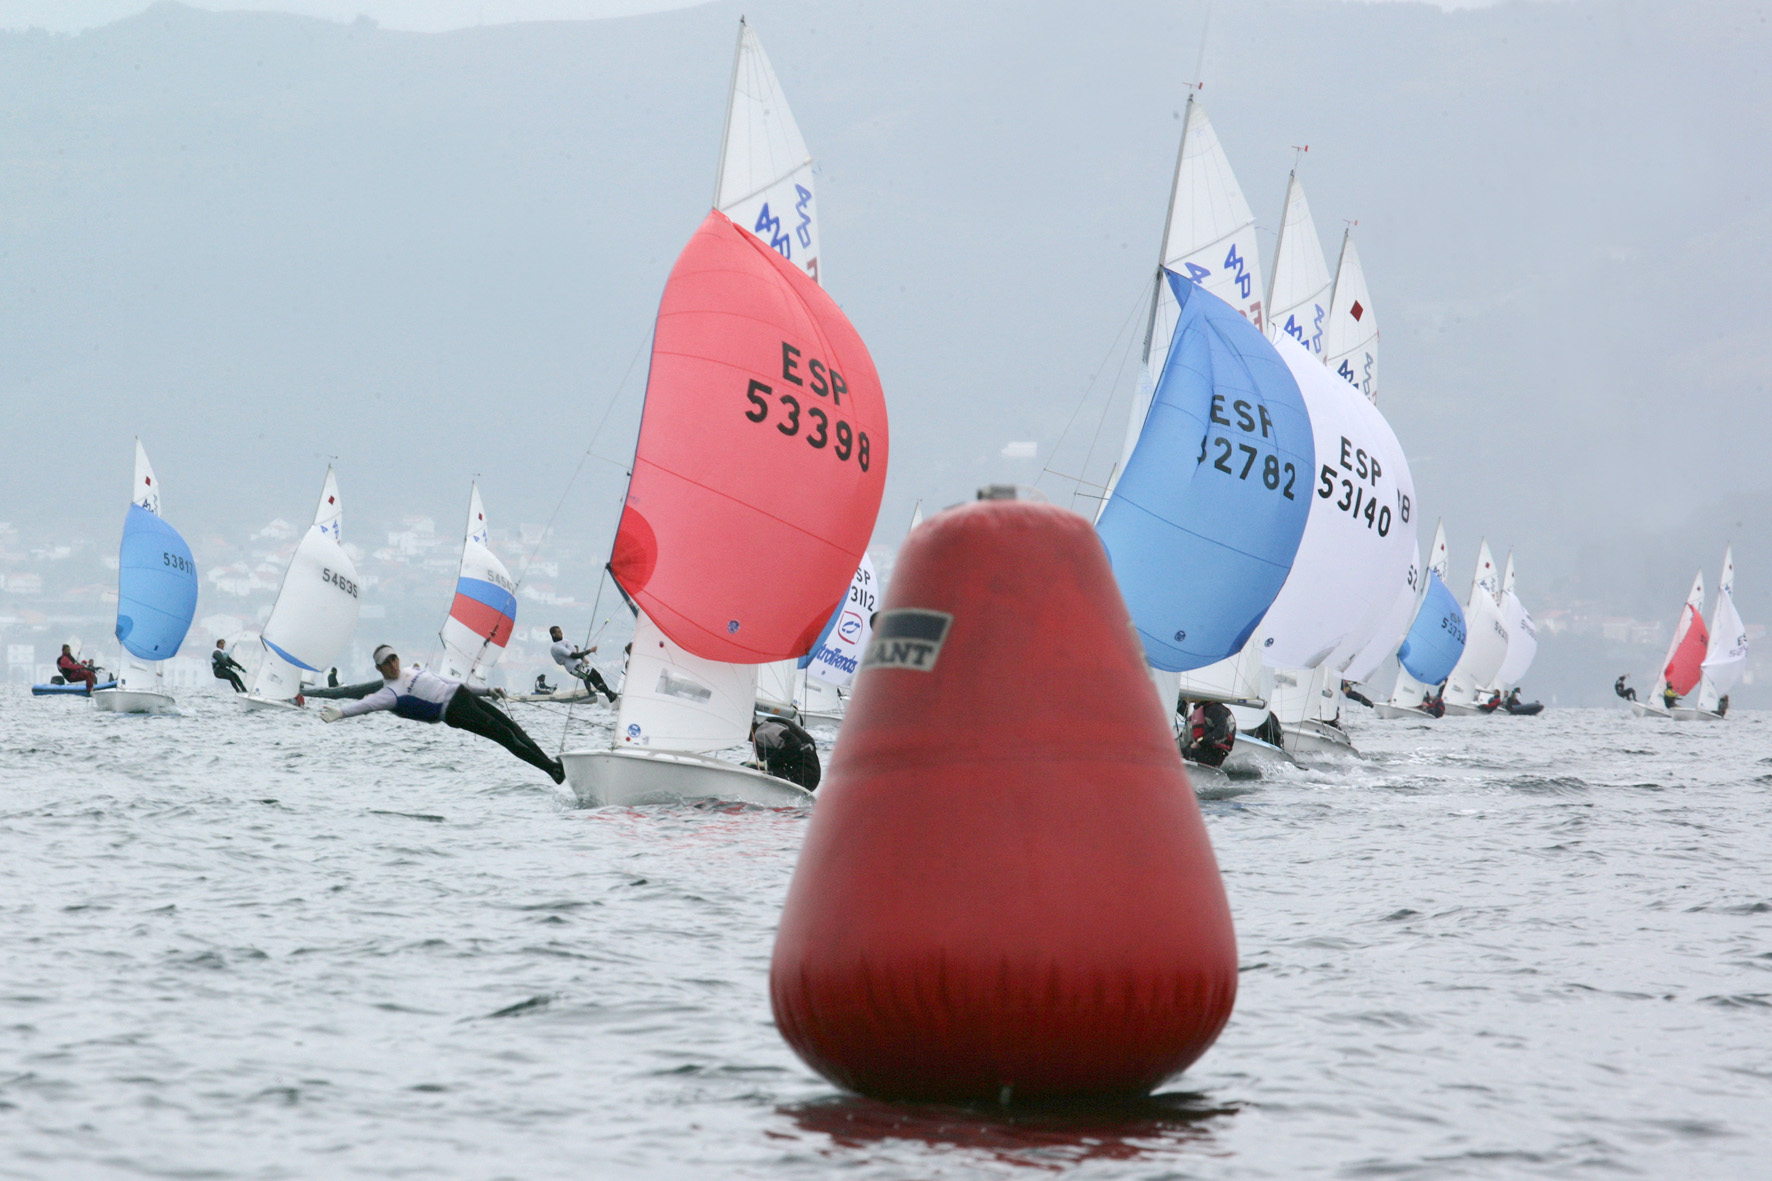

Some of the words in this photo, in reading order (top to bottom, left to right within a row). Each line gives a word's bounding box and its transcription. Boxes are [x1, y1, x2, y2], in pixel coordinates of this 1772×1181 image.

[1224, 243, 1251, 299] 420
[782, 341, 848, 406] ESP
[745, 378, 870, 472] 53398
[1340, 435, 1382, 487] ESP
[1317, 463, 1392, 537] 53140
[163, 552, 193, 576] 53817
[322, 567, 358, 599] 54635
